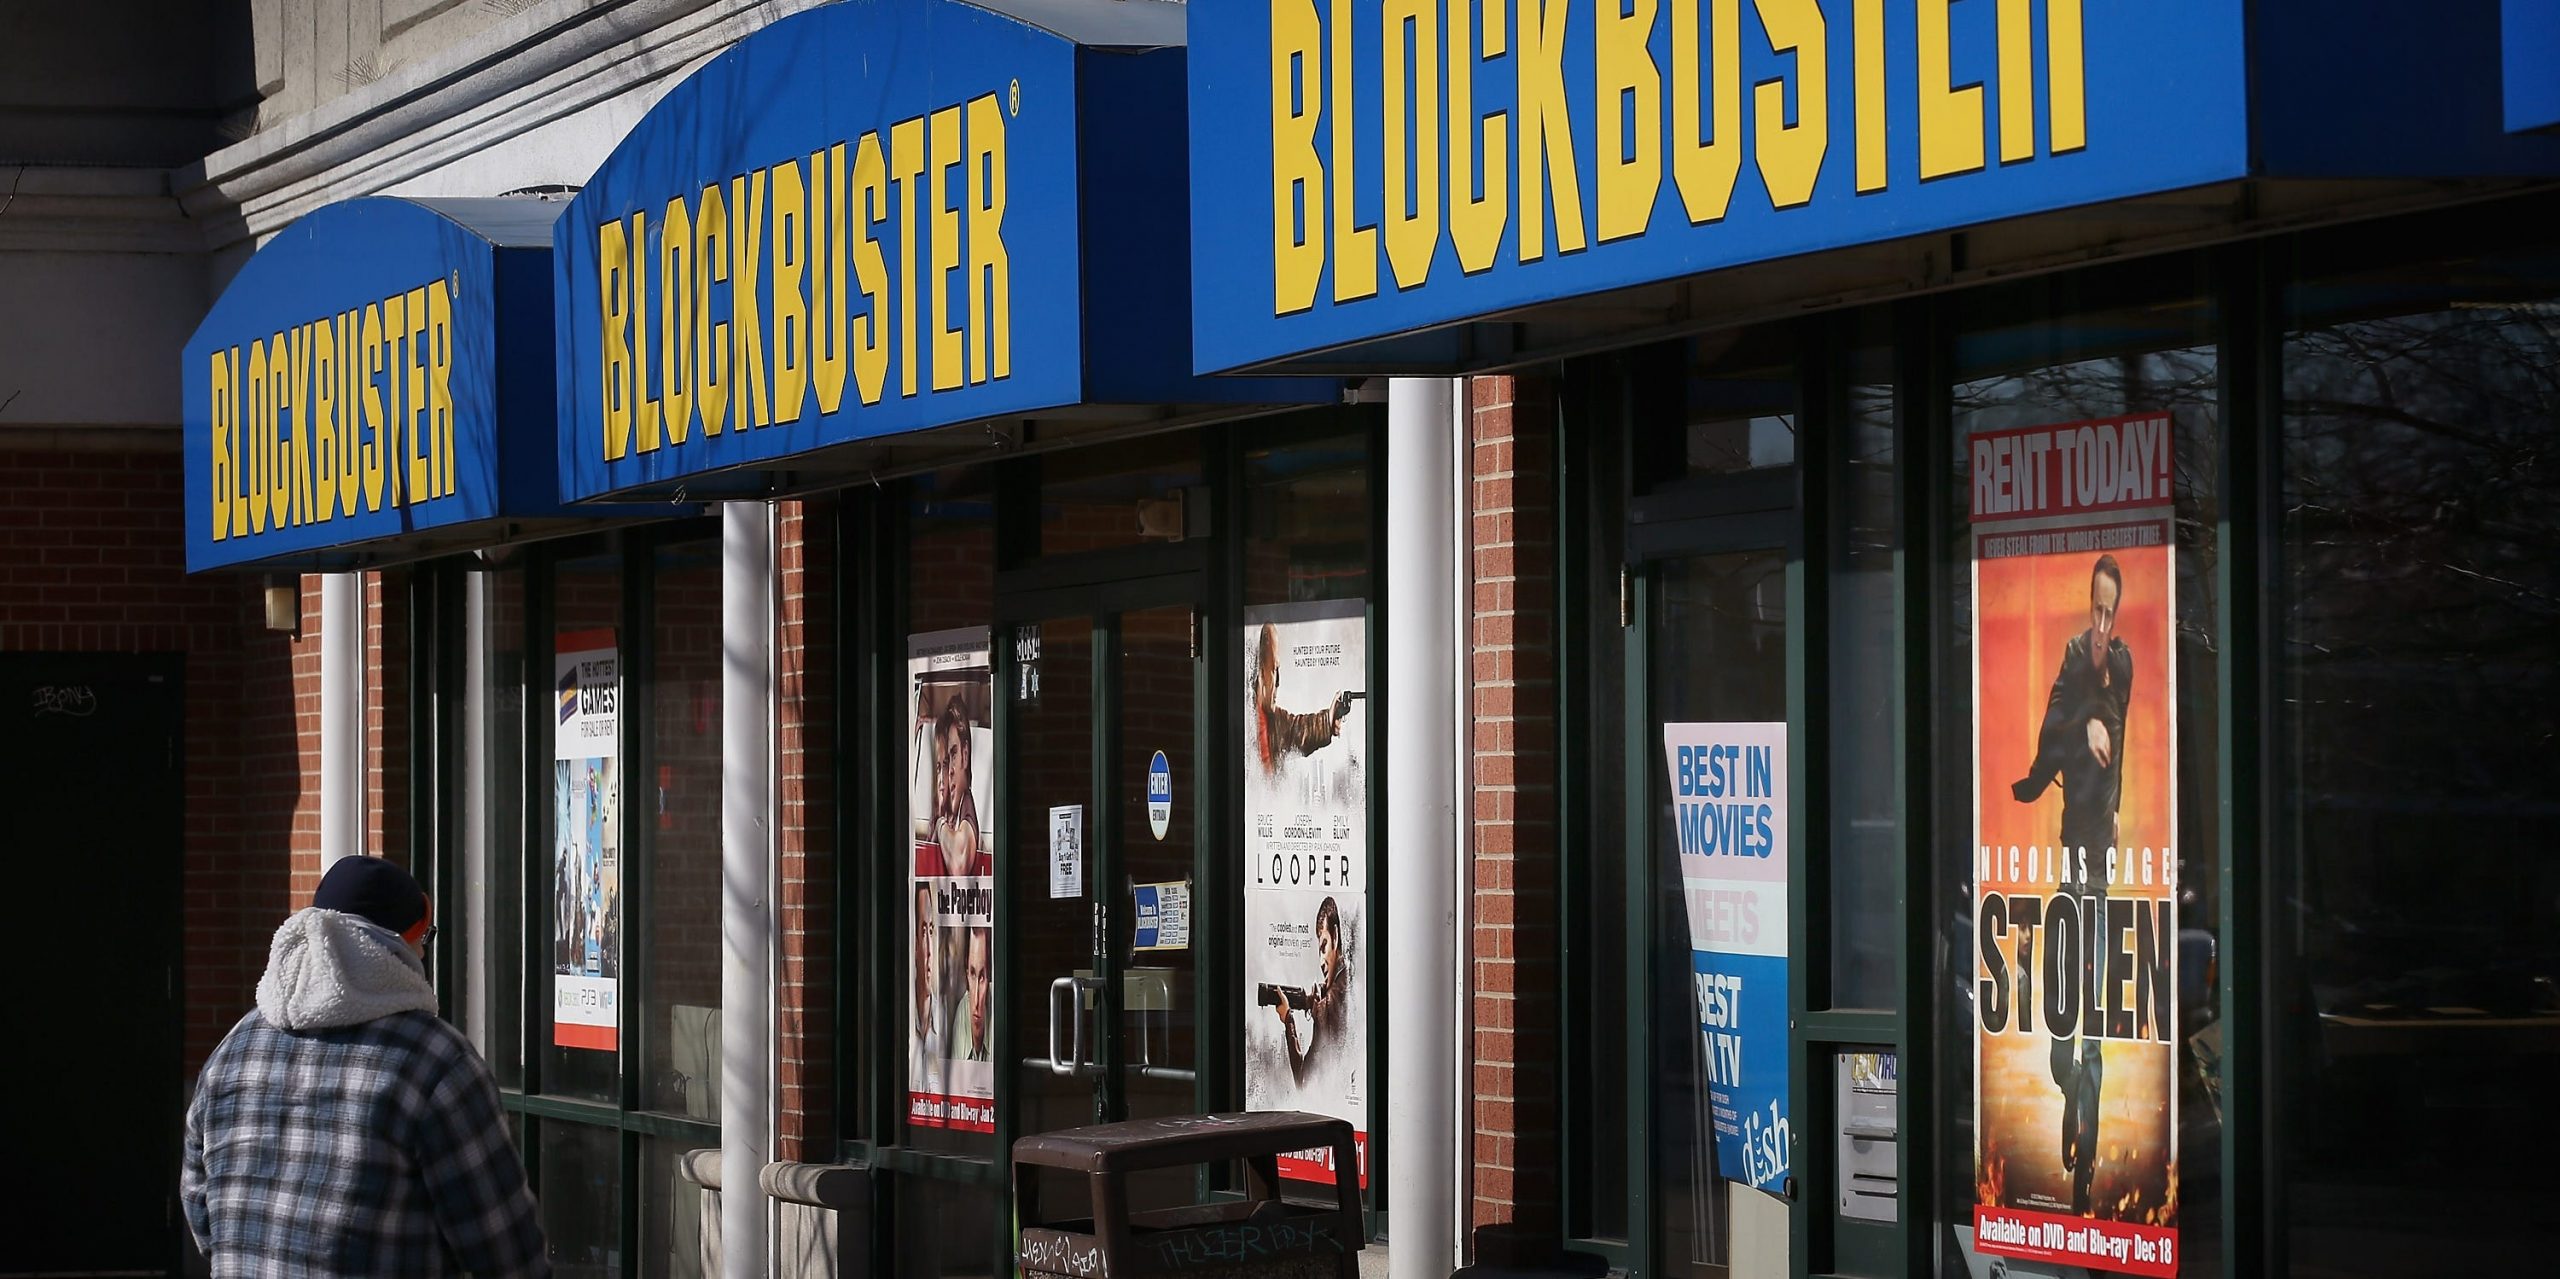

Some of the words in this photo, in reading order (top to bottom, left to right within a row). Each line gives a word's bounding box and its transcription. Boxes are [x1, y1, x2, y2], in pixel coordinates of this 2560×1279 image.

[600, 90, 1011, 462] BLOCKBUSTER
[211, 278, 455, 541] BLOCKBUSTER
[1973, 432, 2051, 515] RENT
[2056, 418, 2169, 507] TODAY!
[1984, 538, 2006, 559] NEVER
[2007, 535, 2028, 557] STEAL
[2029, 534, 2050, 555] FROM
[2051, 532, 2065, 553] THE
[2066, 530, 2100, 553] WORLD'S
[2101, 527, 2136, 550] GREATEST
[581, 661, 591, 678] THE
[593, 659, 615, 677] HOTTEST
[581, 682, 615, 716] GAMES
[1677, 744, 1740, 798] BEST
[1746, 746, 1771, 797] IN
[1258, 827, 1272, 838] WILLIS
[1333, 828, 1350, 839] BLUNT
[1680, 802, 1773, 858] MOVIES
[1257, 853, 1350, 887] LOOPER
[1981, 846, 2088, 884] NICOLAS
[2106, 846, 2170, 885] CAGE
[951, 882, 992, 923] Paperboy
[1979, 890, 2172, 1045] STOLEN
[1717, 1034, 1741, 1088] TV
[911, 1097, 933, 1117] Available
[934, 1103, 940, 1118] on
[951, 1102, 960, 1120] and
[980, 1104, 989, 1122] Jan
[1742, 1098, 1789, 1189] dish
[1979, 1214, 2026, 1246] Available
[2028, 1227, 2041, 1244] on
[2043, 1222, 2065, 1250] DVD
[2067, 1228, 2087, 1254] and
[2089, 1228, 2130, 1264] Blu-ray
[2134, 1234, 2156, 1263] Dec
[2159, 1237, 2172, 1264] 18
